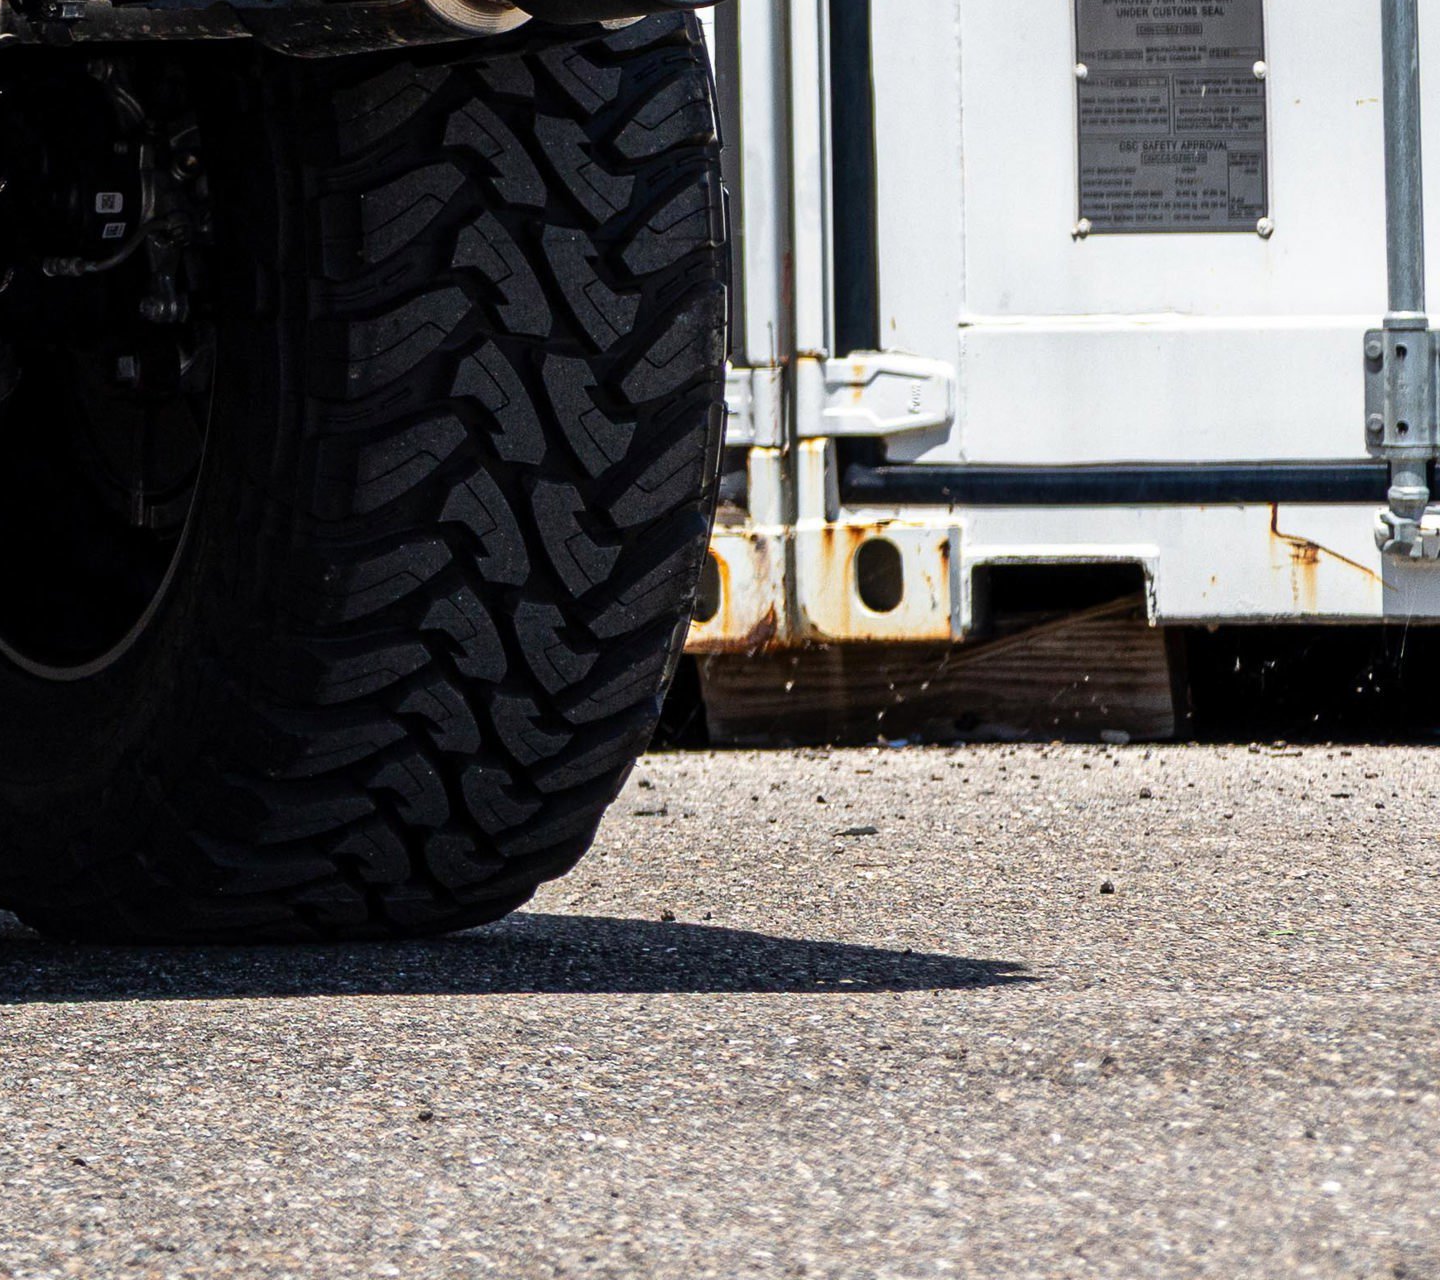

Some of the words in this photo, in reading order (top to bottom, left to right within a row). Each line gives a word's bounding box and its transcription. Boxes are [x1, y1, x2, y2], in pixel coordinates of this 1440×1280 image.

[1116, 7, 1149, 18] UNDER
[1153, 6, 1198, 17] CUSTOMS
[1201, 5, 1225, 16] SEAL
[1142, 140, 1177, 151] SAFETY
[1180, 139, 1228, 150] APPROVAL
